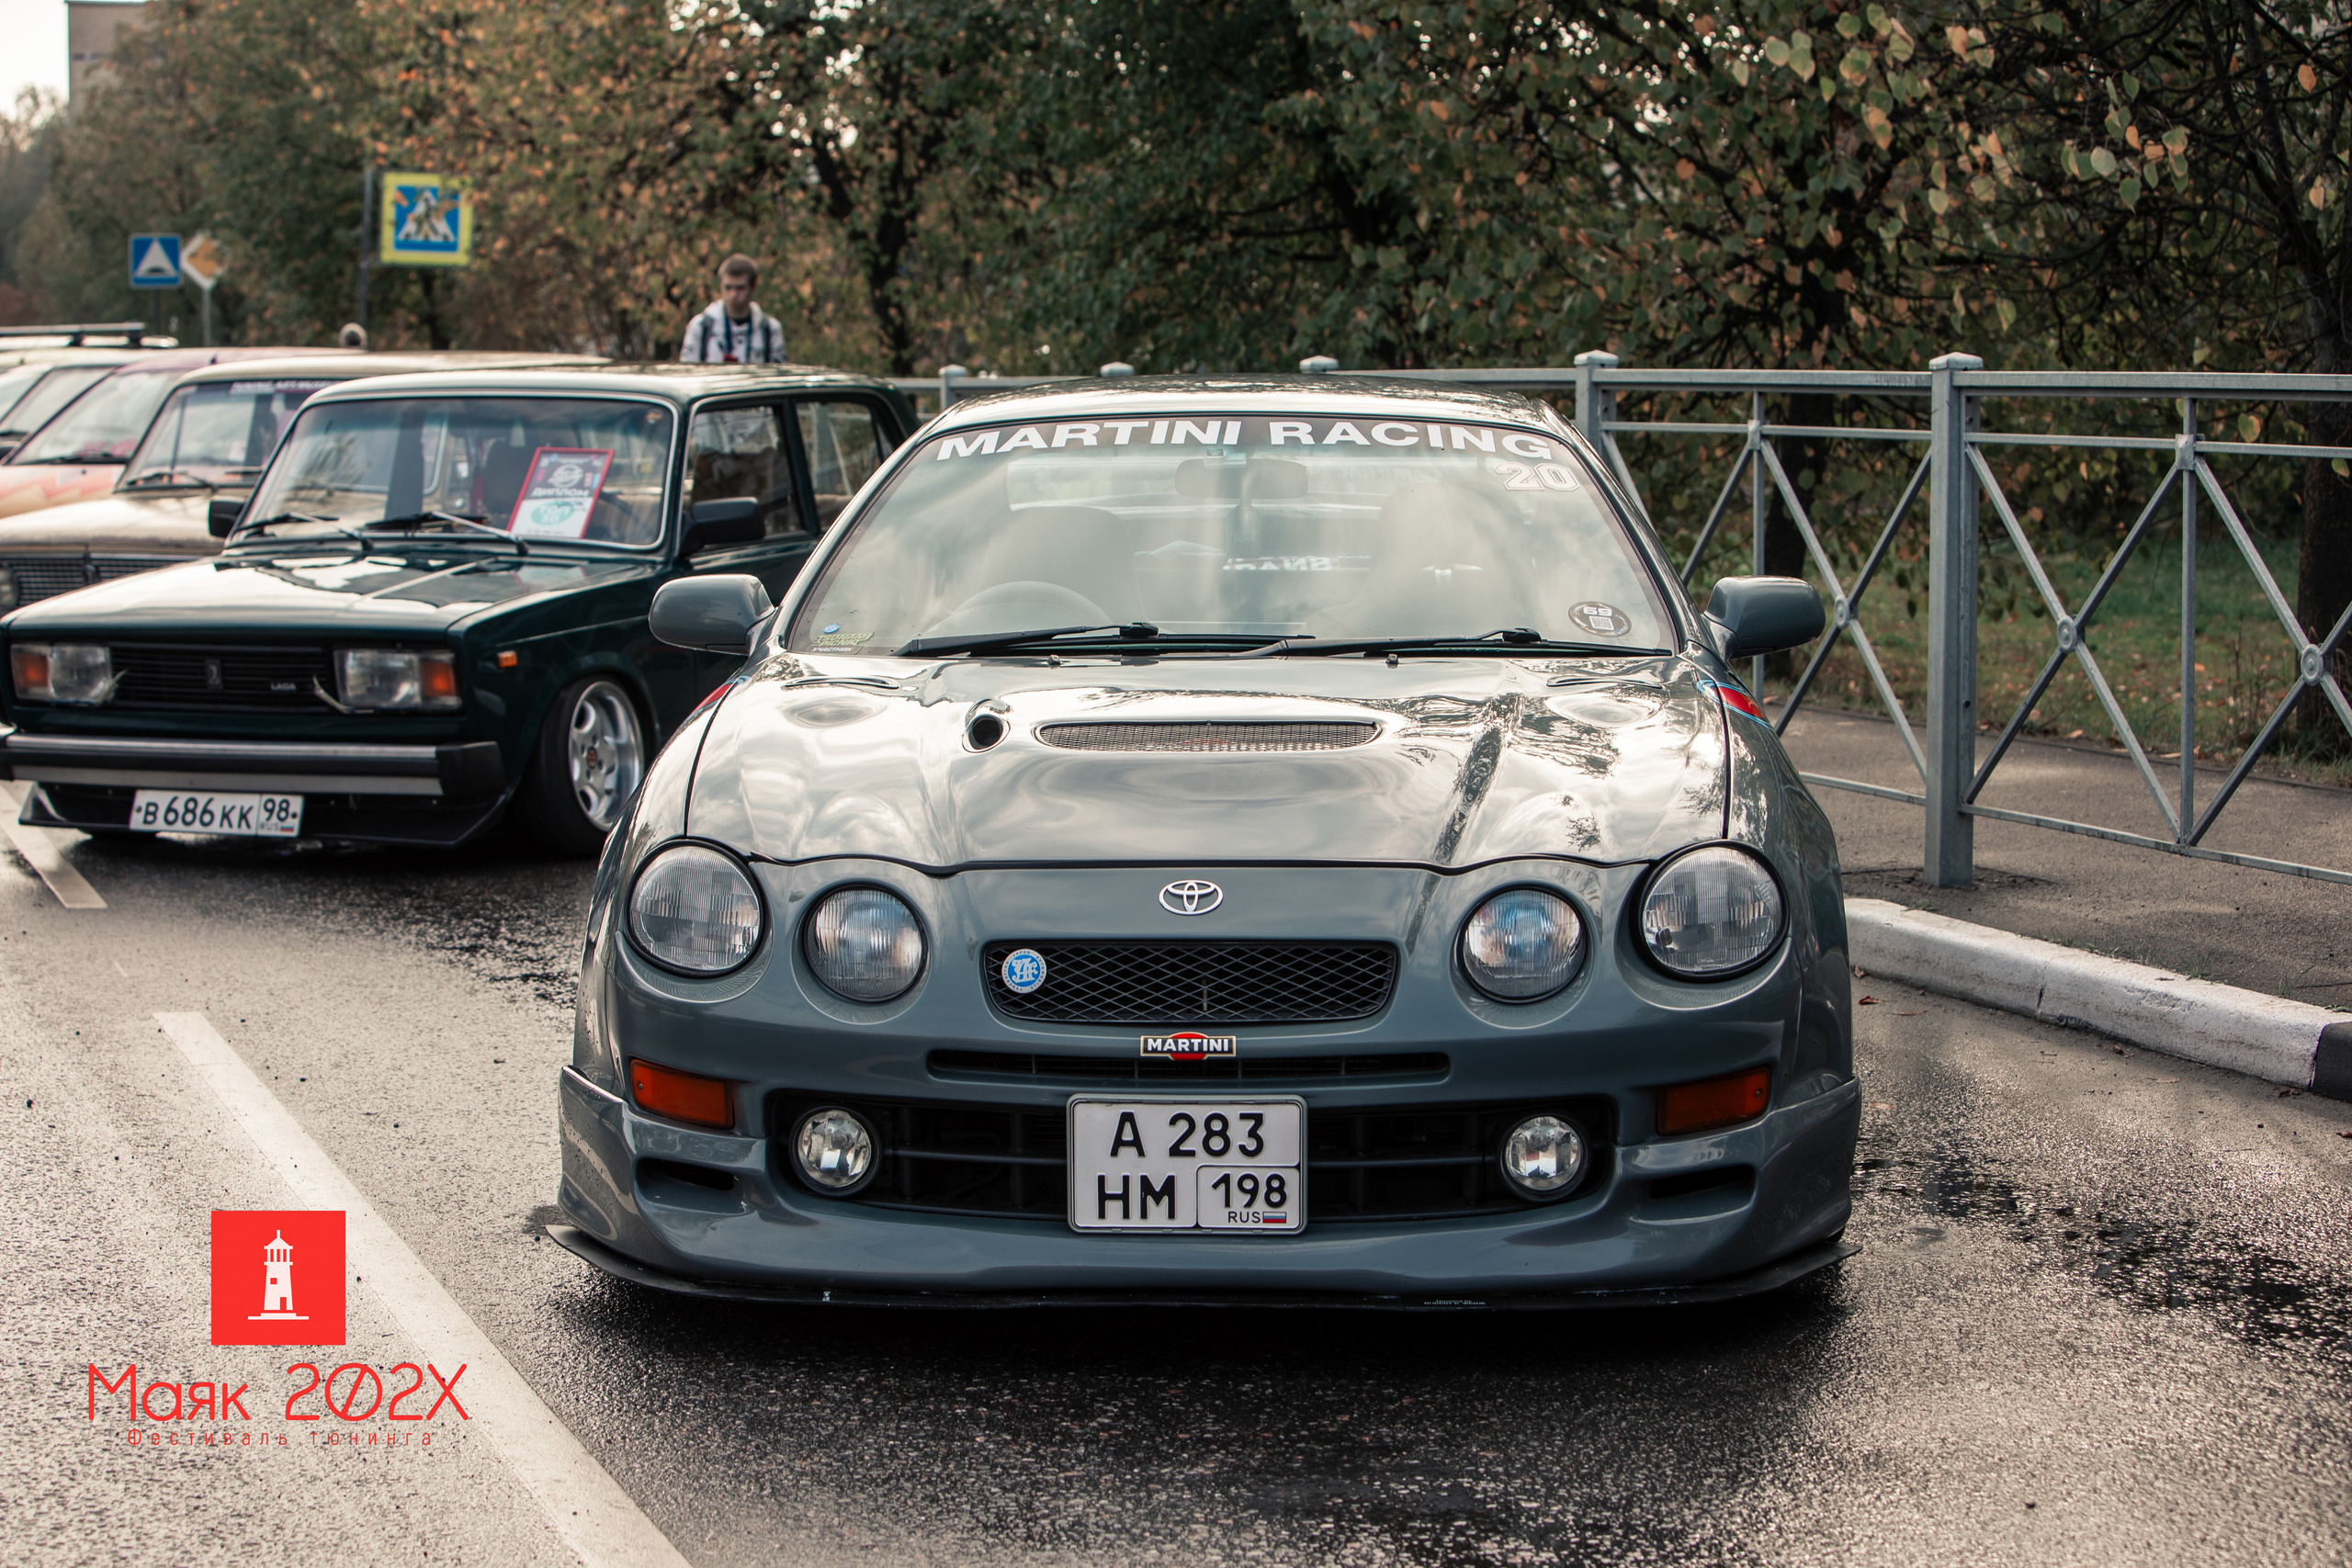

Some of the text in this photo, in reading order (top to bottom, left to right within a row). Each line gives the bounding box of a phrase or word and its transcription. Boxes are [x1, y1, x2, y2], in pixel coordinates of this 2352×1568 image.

[937, 420, 1553, 461] MARTINI RACING
[1494, 462, 1580, 491] 20
[530, 487, 590, 498] ДИПЛОМ
[1583, 606, 1612, 616] 69
[814, 633, 873, 643] TSUNAMI
[262, 797, 290, 822] 98
[260, 822, 279, 830] RUS
[1147, 1038, 1229, 1052] MARTINI
[1168, 1111, 1265, 1157] 283
[1097, 1173, 1287, 1220] НМ 198
[1227, 1211, 1261, 1224] RUS
